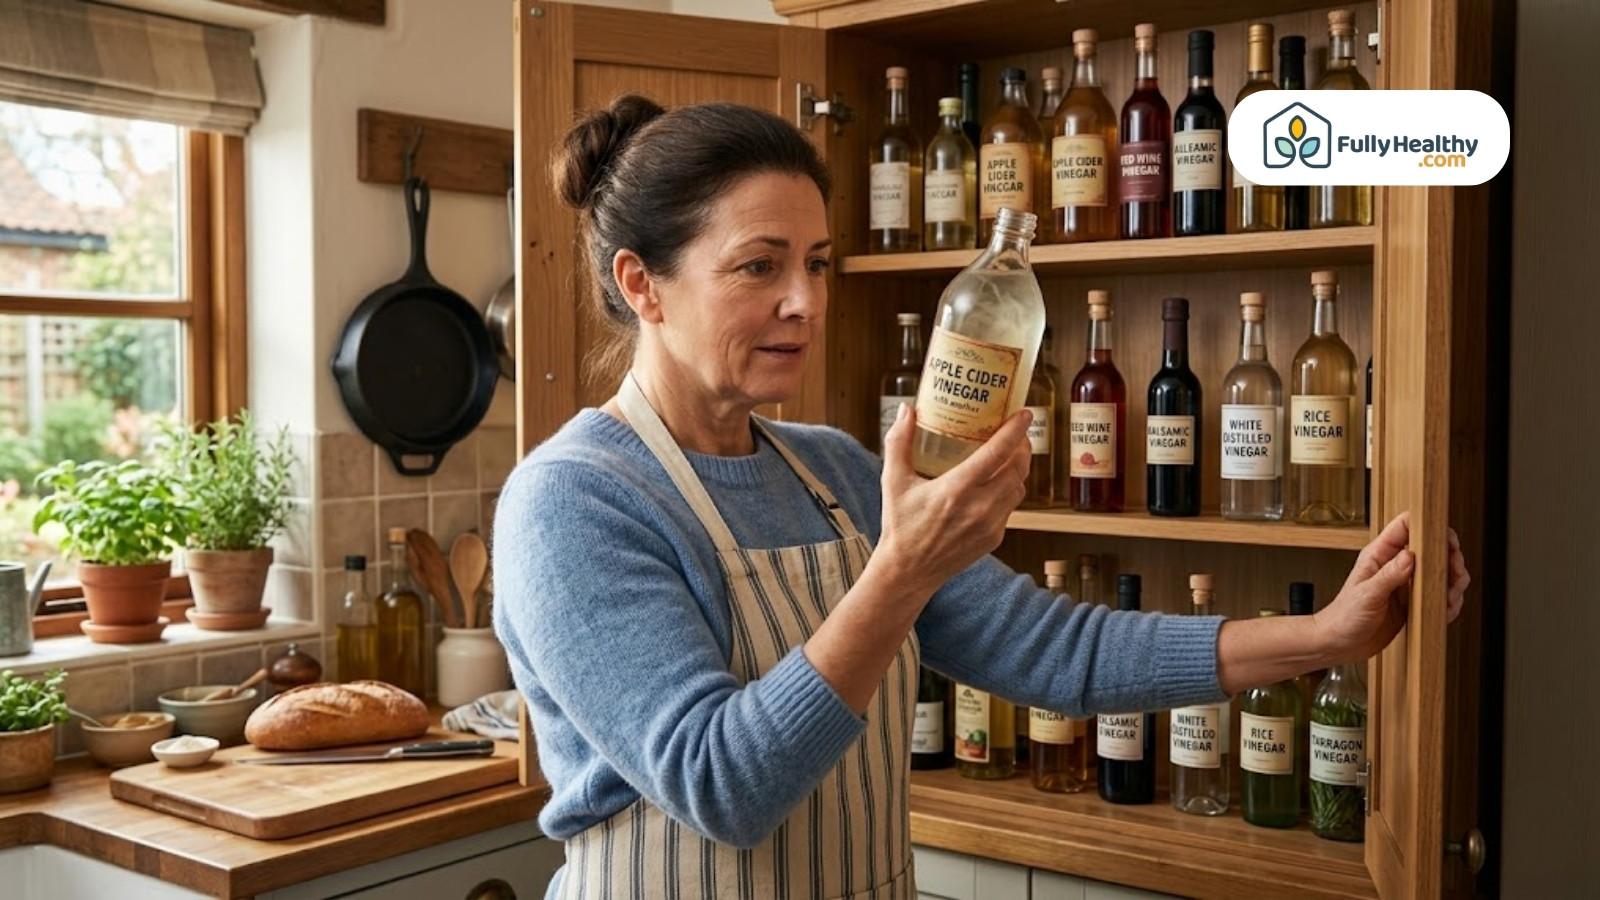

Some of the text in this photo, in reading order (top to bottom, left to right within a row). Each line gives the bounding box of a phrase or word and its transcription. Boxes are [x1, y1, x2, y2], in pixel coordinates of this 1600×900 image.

[987, 159, 1017, 170] APPLE
[1075, 156, 1104, 166] CIDER
[1056, 168, 1097, 180] VINEGAR
[929, 357, 1009, 389] APPLE CIDER
[933, 376, 990, 403] VINEGAR
[1303, 410, 1331, 423] RICE
[1086, 423, 1112, 433] WINE
[1229, 419, 1263, 431] WHITE
[1293, 425, 1344, 438] VINEGAR
[1223, 433, 1272, 444] DISTILLED
[1225, 446, 1269, 458] VINEGAR
[1177, 713, 1208, 727] WHITE
[1251, 728, 1275, 740] RICE
[1173, 739, 1213, 752] VINEGAR
[1243, 739, 1286, 754] VINEGAR
[1312, 734, 1363, 751] TARRAGON
[1314, 749, 1358, 764] VINEGAR
